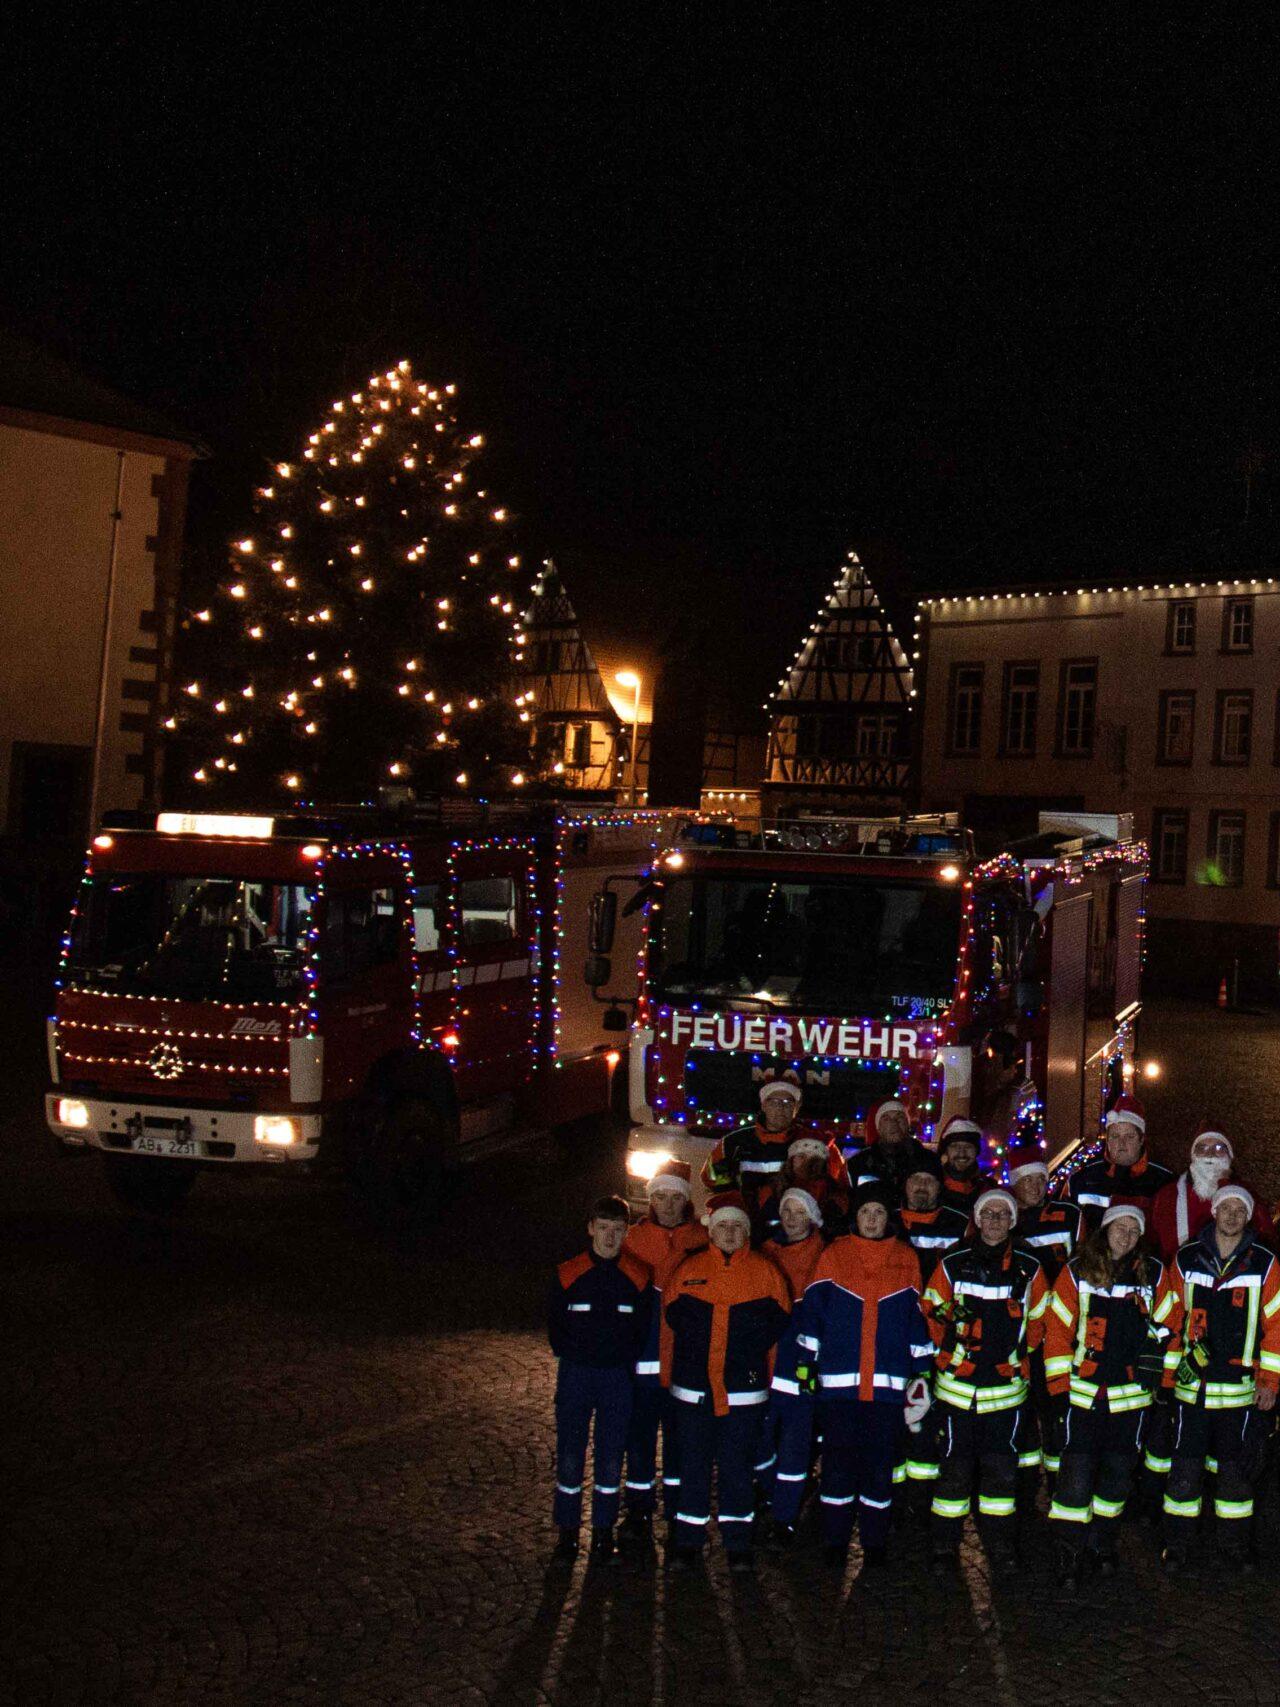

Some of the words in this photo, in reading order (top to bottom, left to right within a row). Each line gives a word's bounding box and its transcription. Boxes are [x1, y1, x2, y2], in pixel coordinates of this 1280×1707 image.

[891, 995, 909, 1006] TLF
[911, 997, 935, 1008] 20/40
[937, 998, 949, 1009] SL
[671, 1015, 919, 1059] FEUERWEHR
[751, 1065, 831, 1086] MAN
[138, 1138, 155, 1151] AB
